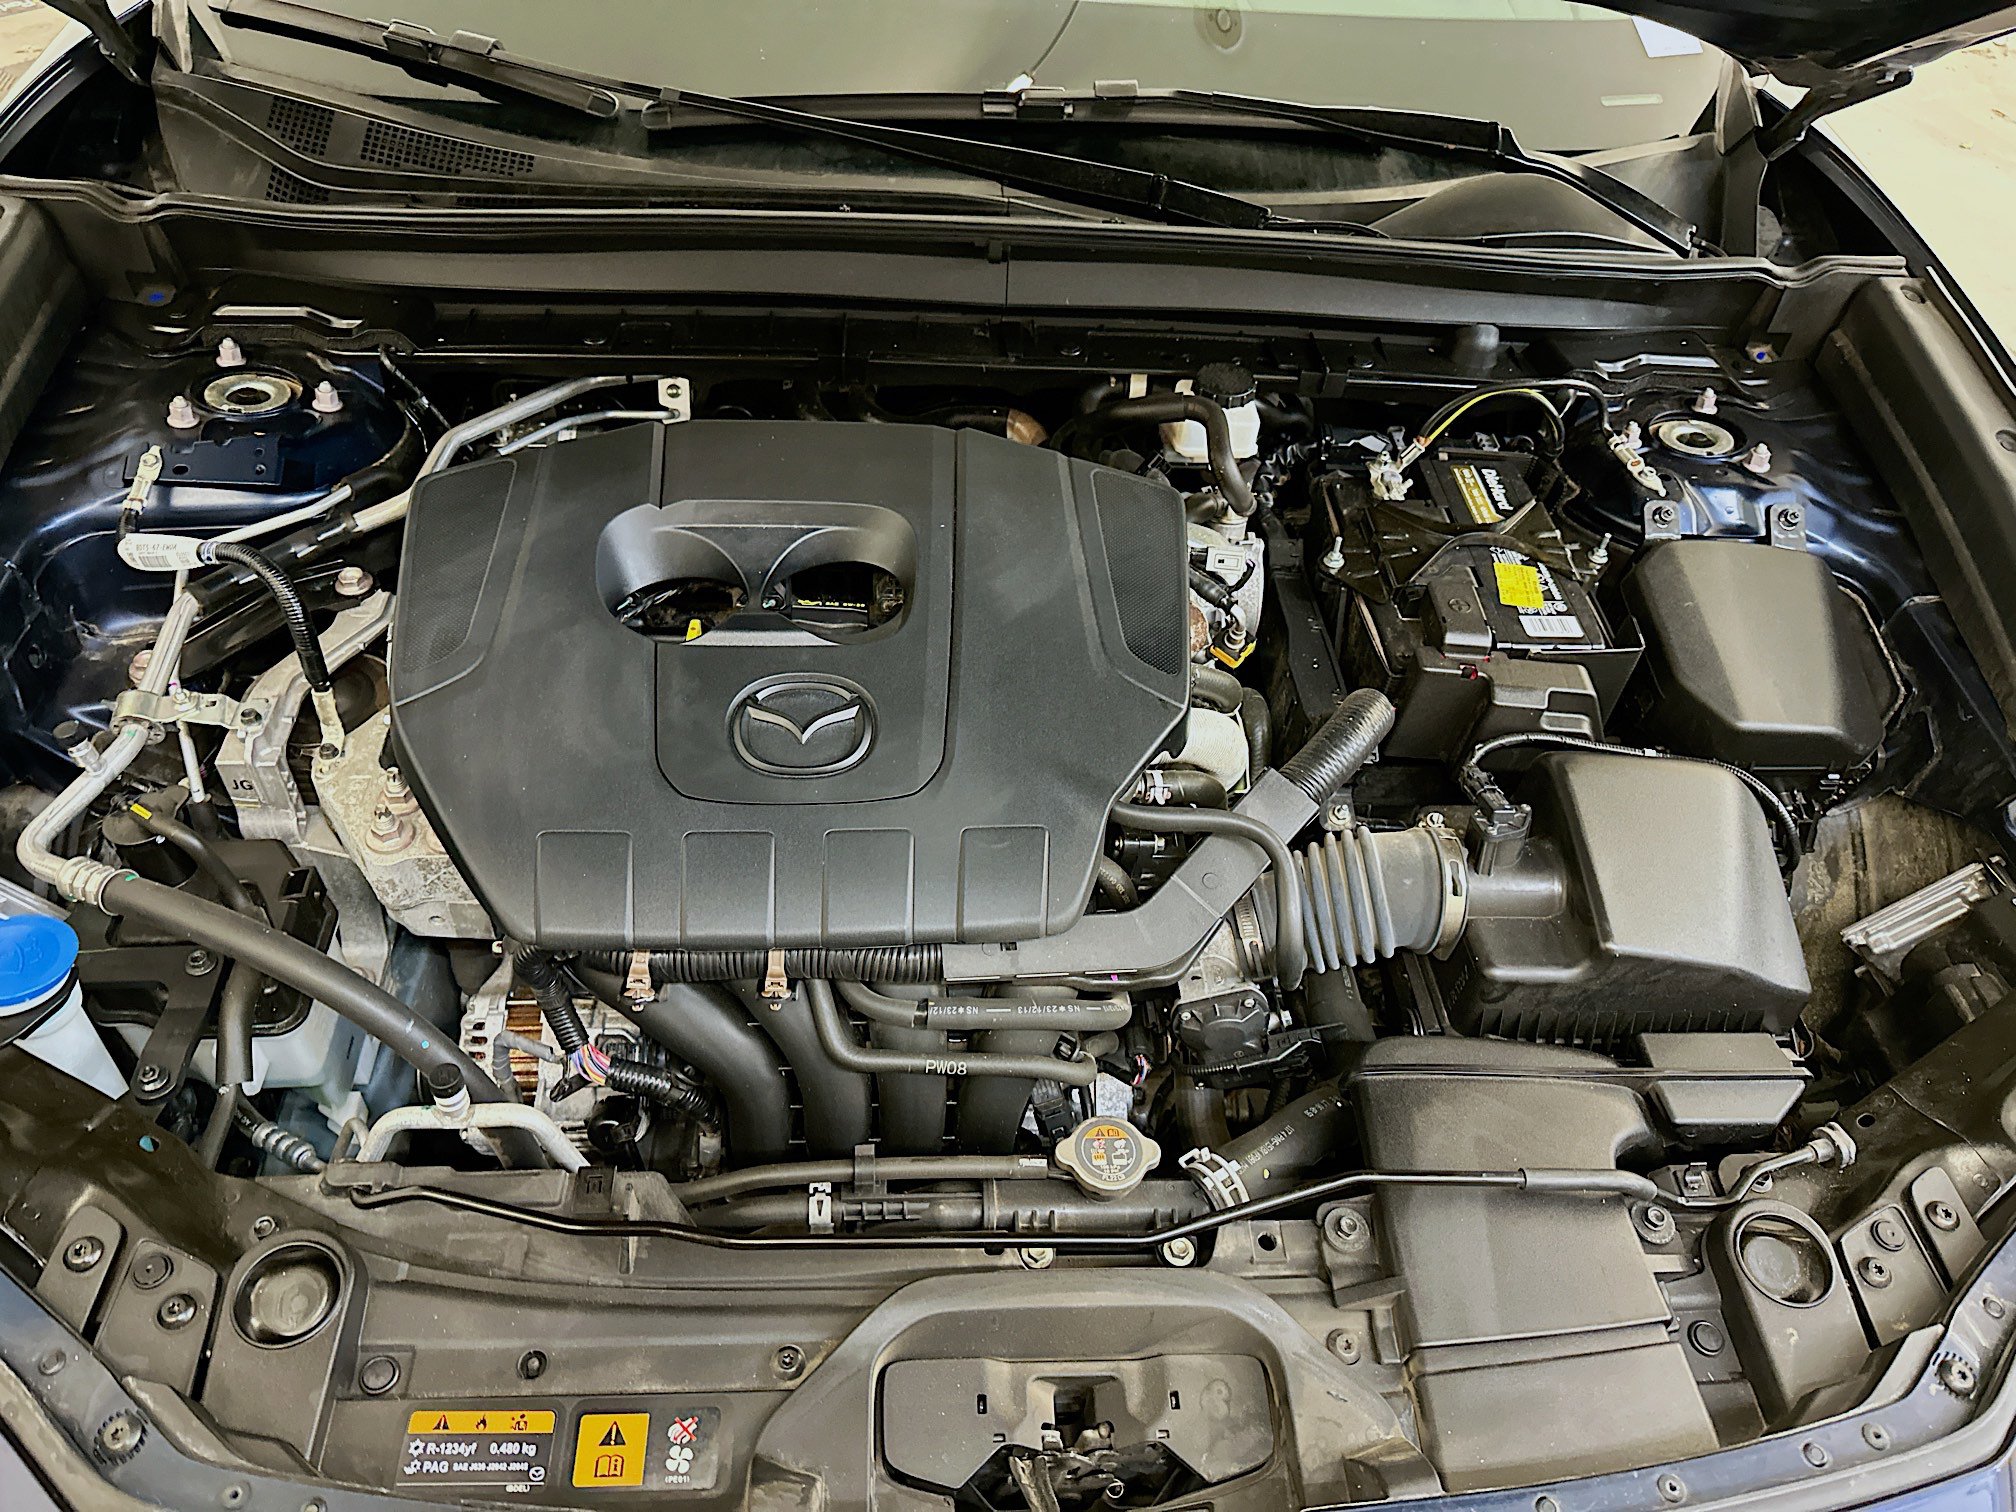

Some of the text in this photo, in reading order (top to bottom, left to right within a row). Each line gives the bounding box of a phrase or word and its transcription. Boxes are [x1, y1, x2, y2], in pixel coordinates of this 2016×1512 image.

[1481, 468, 1514, 511] DieHard
[232, 779, 254, 790] JG
[925, 1059, 967, 1075] PW08
[426, 1442, 477, 1457] R-1234yf
[521, 1442, 537, 1457] kg
[422, 1460, 449, 1473] PAG
